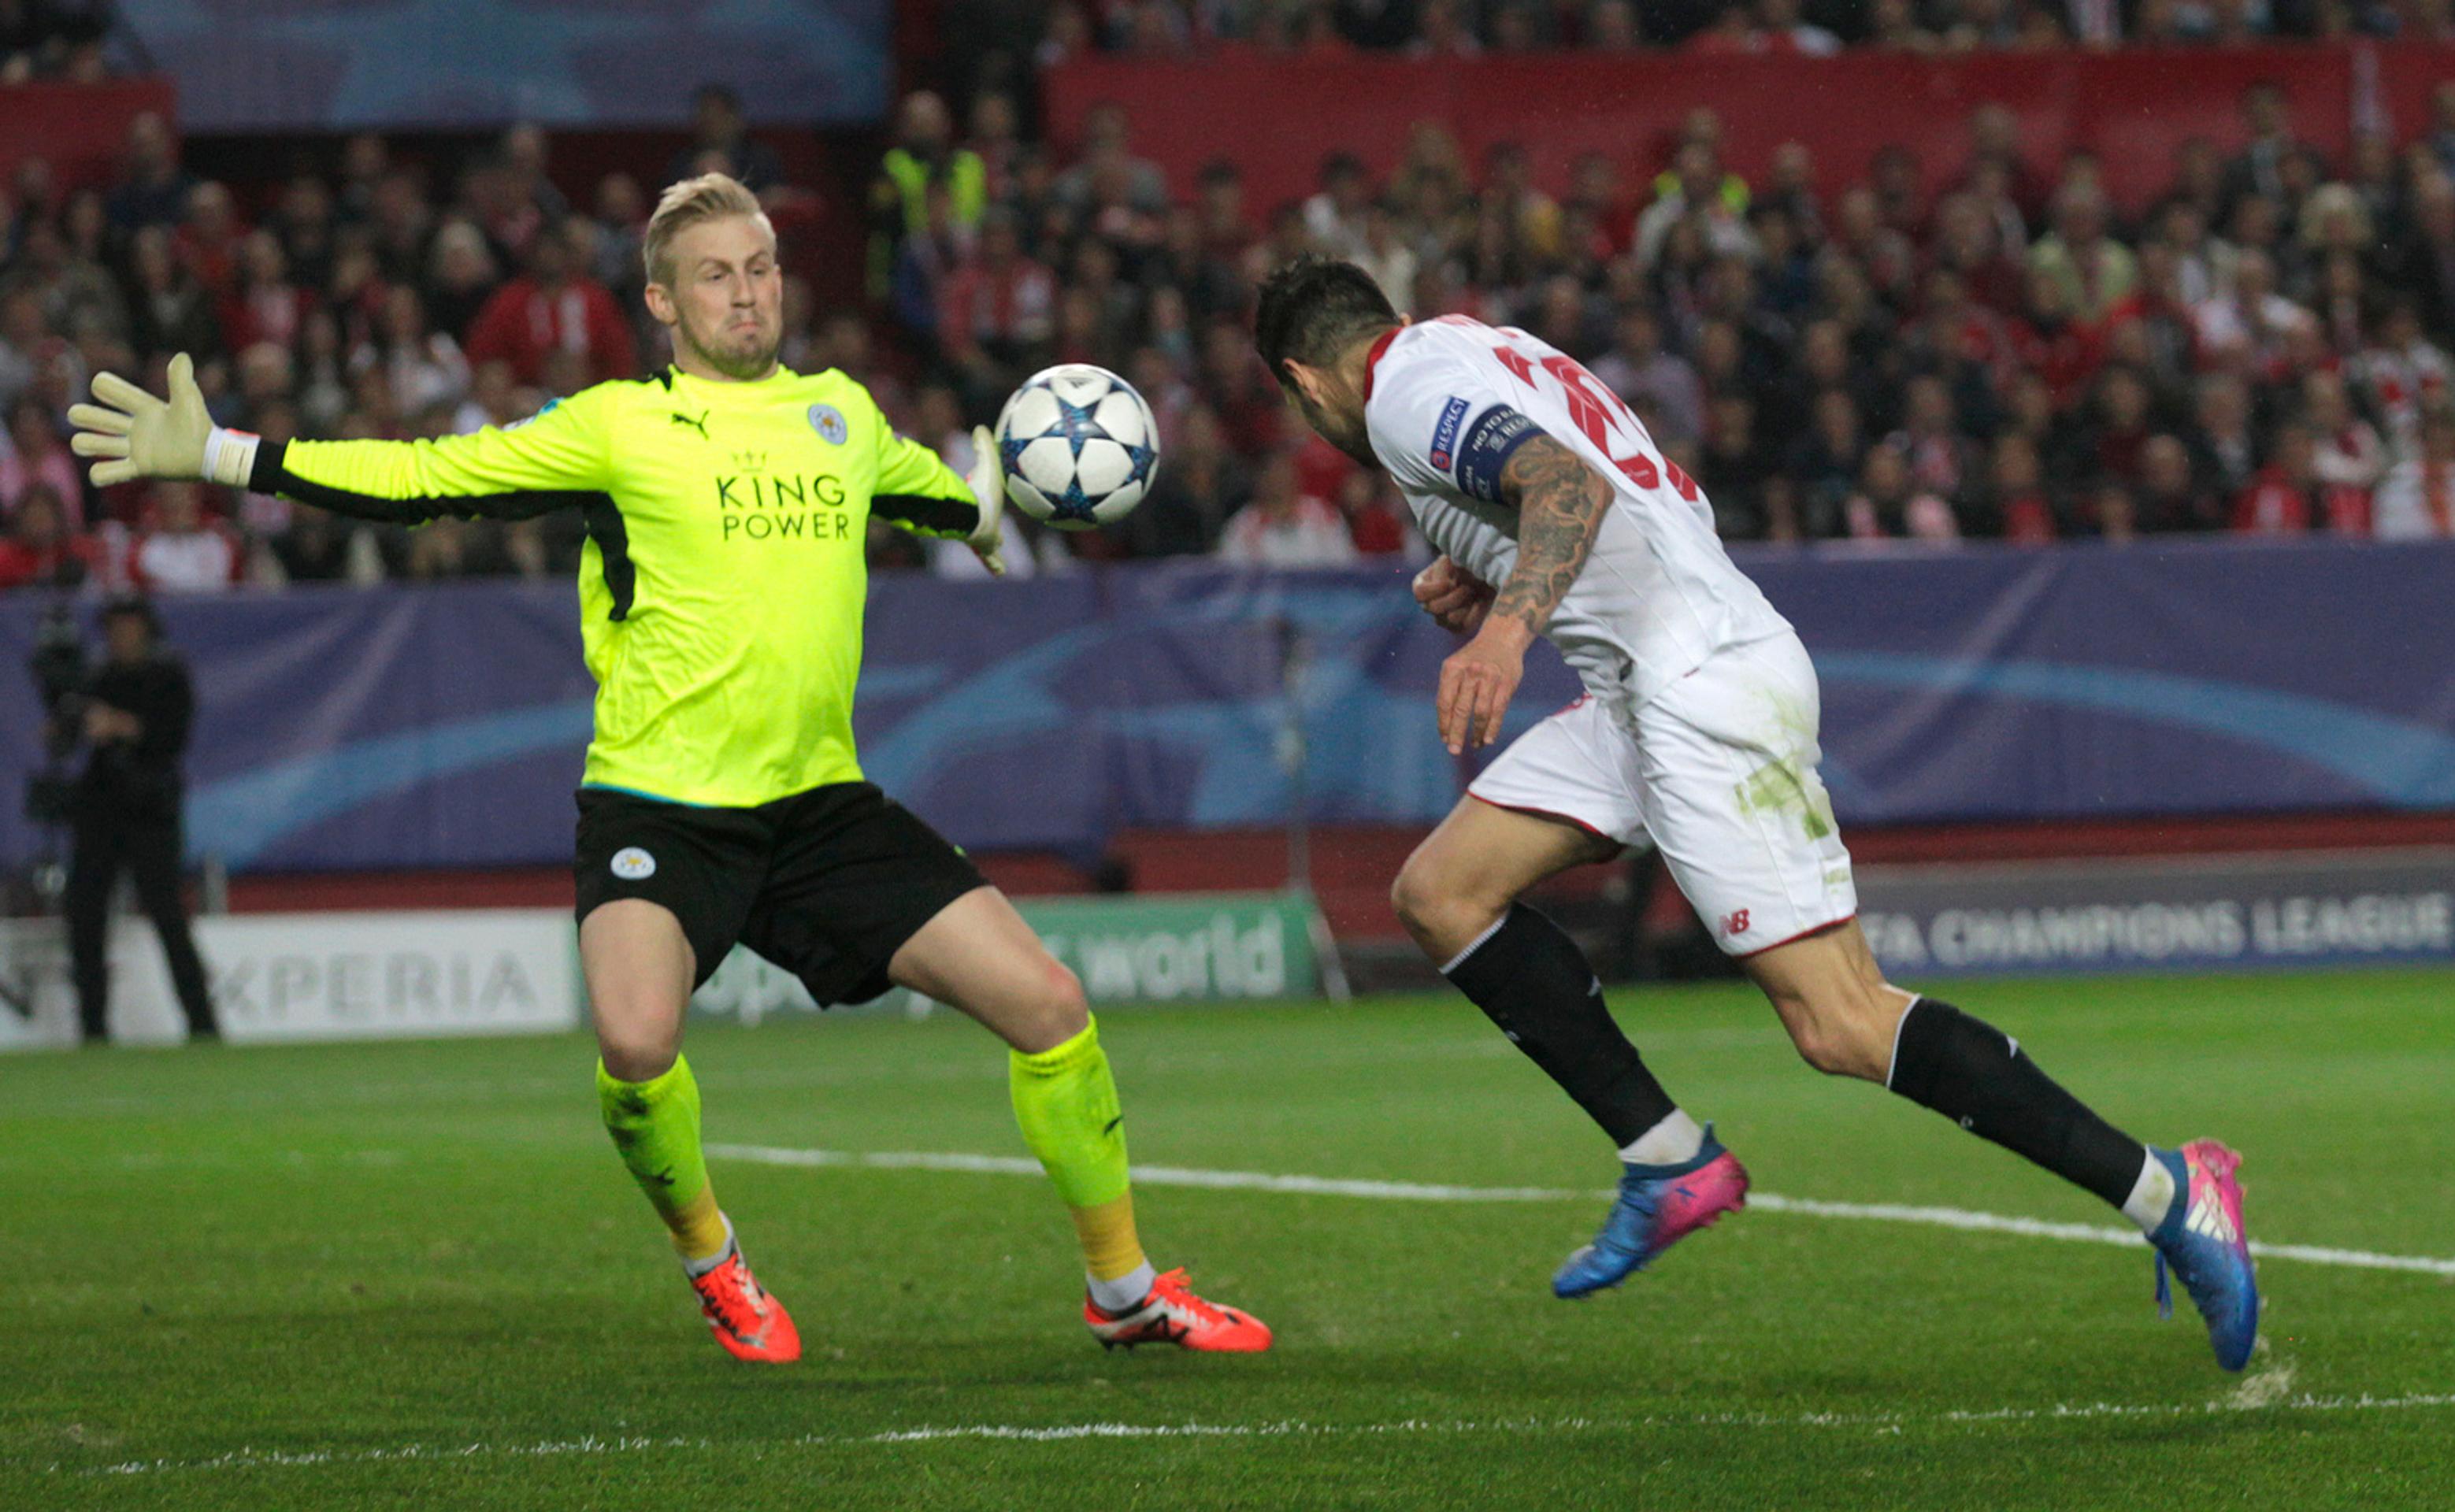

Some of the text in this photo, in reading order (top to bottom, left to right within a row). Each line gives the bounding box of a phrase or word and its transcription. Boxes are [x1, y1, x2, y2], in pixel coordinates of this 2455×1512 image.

[1437, 397, 1467, 452] RESPECT
[715, 474, 846, 509] KING
[723, 513, 849, 542] POWER
[1080, 912, 1283, 999] world
[1929, 901, 2245, 965] CHAMPIONS
[2252, 892, 2449, 953] LEAGUE
